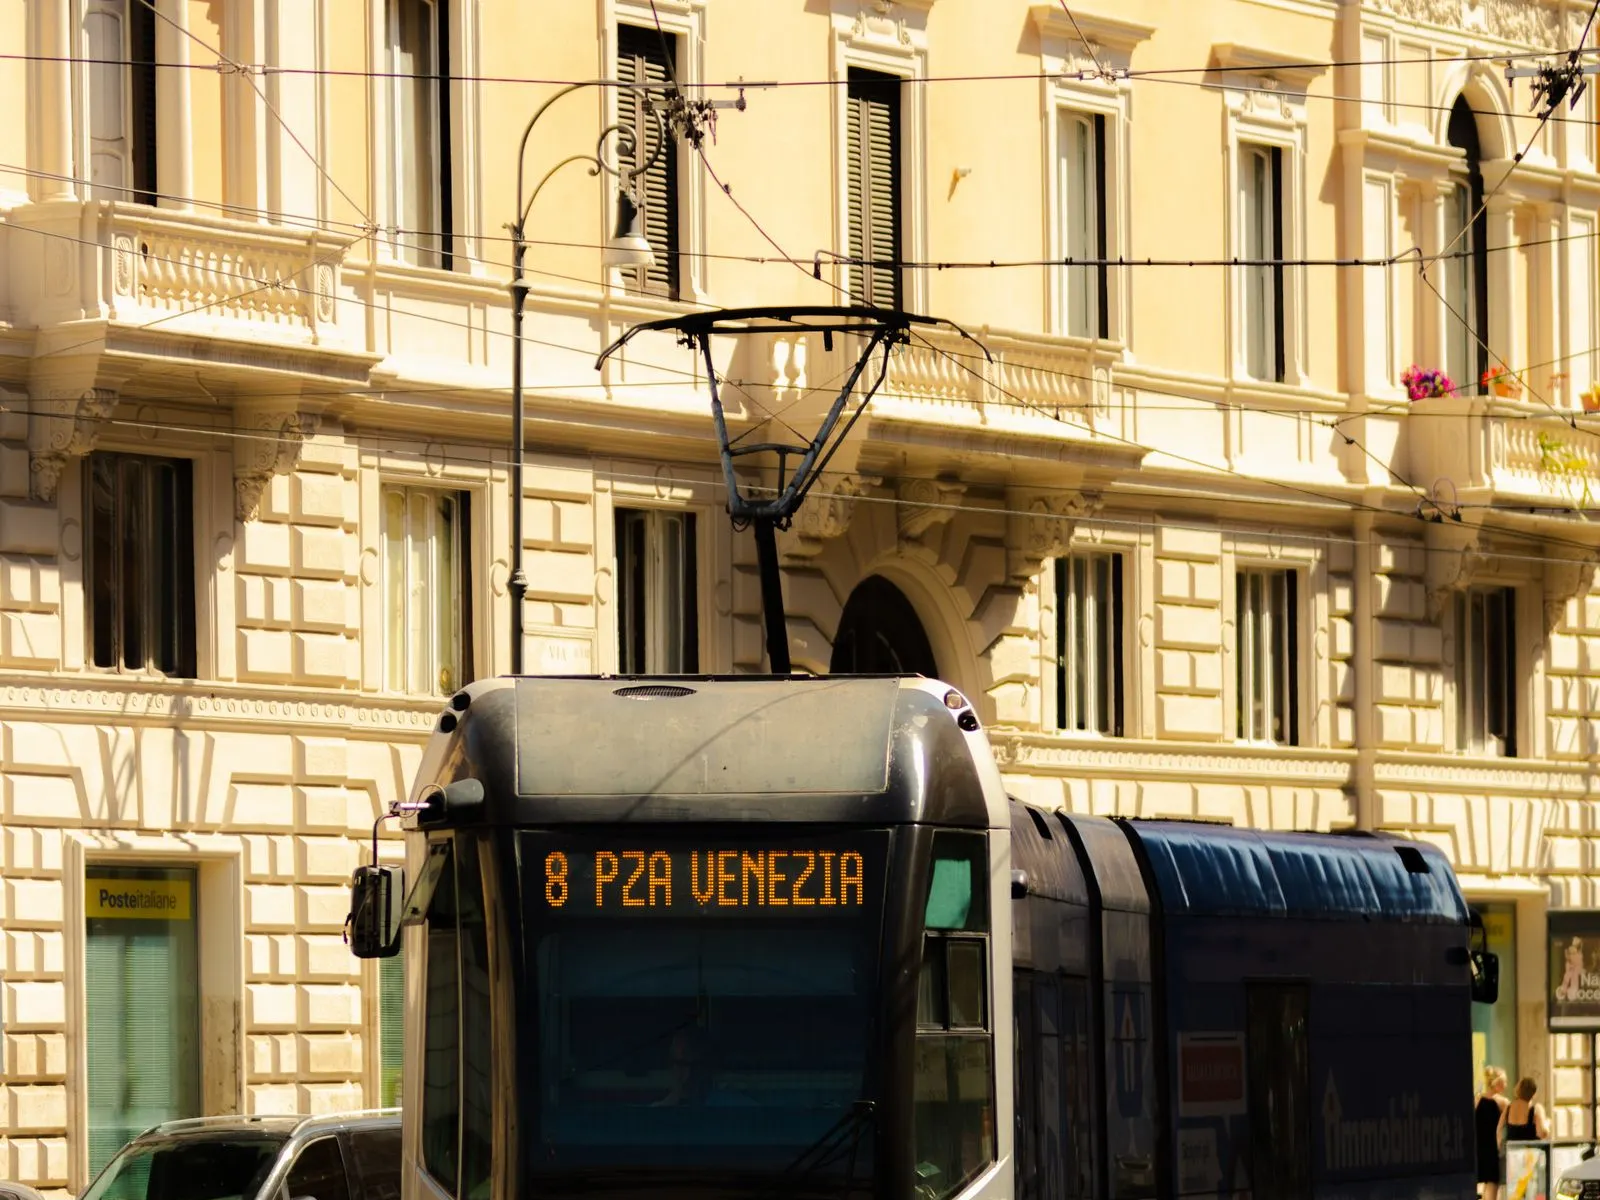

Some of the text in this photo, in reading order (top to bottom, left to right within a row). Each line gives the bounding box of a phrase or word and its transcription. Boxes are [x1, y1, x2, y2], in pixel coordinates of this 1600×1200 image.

[545, 850, 863, 907] 8 PZA VENEZIA
